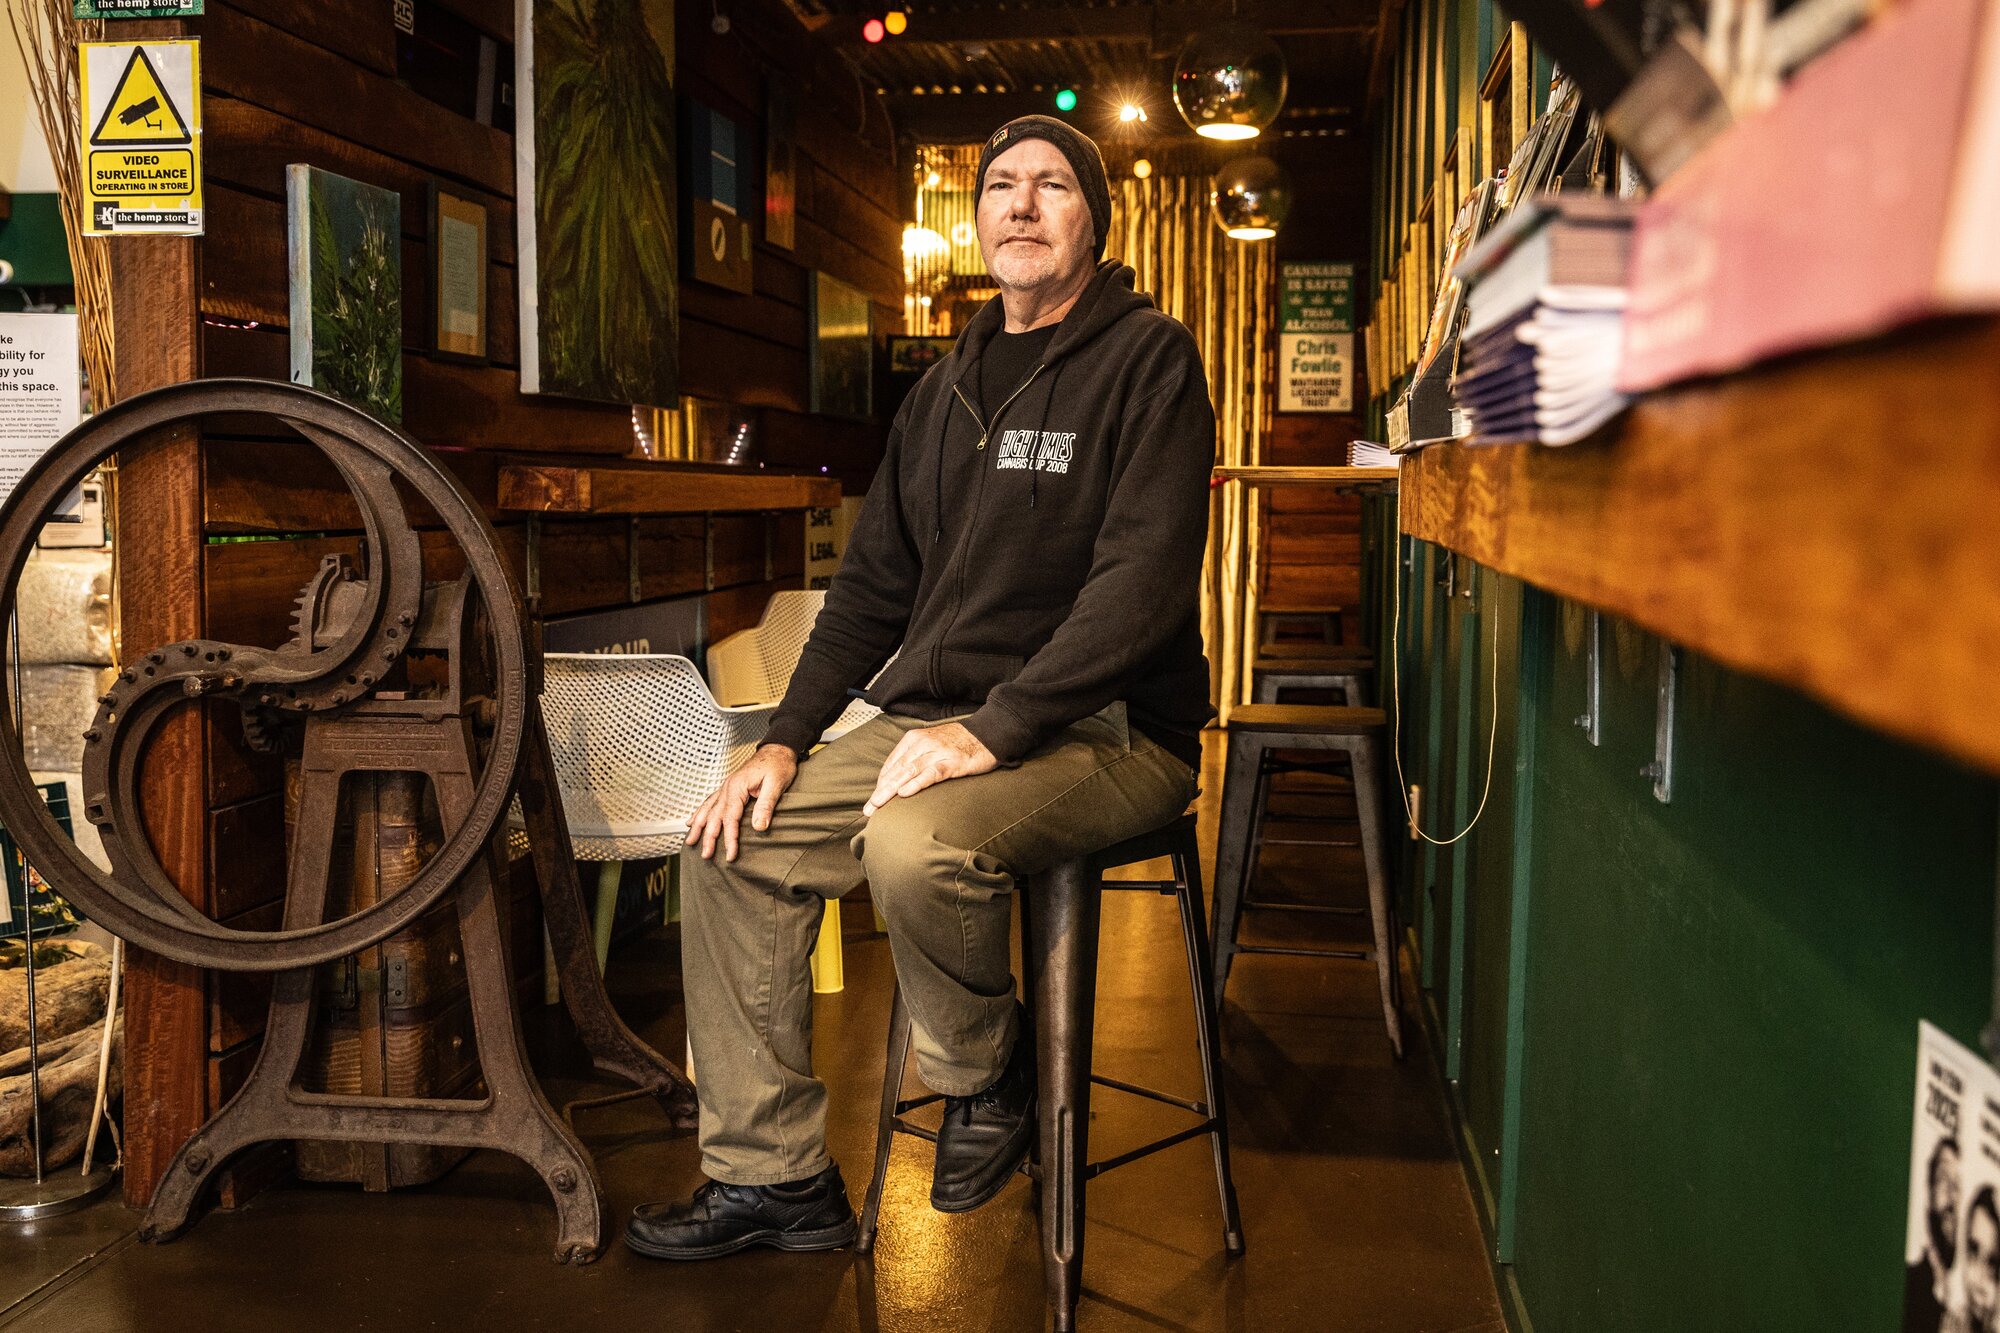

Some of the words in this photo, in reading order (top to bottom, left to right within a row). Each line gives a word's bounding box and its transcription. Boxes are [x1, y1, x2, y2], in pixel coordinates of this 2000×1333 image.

[98, 0, 115, 8] the
[117, 0, 150, 9] hemp
[123, 155, 159, 165] VIDEO
[97, 169, 187, 180] SURVEILLANCE
[96, 182, 146, 191] OPERATING
[148, 182, 157, 190] IN
[160, 182, 188, 190] STORE
[118, 213, 132, 222] the
[134, 212, 162, 223] hemp
[164, 213, 187, 222] store
[1283, 264, 1353, 276] CANNABIS
[1287, 279, 1301, 291] IS
[1304, 279, 1348, 291] SAFER
[1302, 307, 1333, 318] THAN
[1285, 320, 1348, 331] ALCOHOL
[1297, 339, 1337, 355] Chris
[29, 350, 45, 360] for
[1291, 358, 1342, 373] Fowlie
[13, 368, 34, 378] you
[22, 383, 59, 393] space.
[1291, 388, 1340, 397] LICENSING
[1301, 398, 1331, 407] TRUST
[998, 429, 1035, 459] HIGH
[1030, 430, 1076, 462] TIMES
[996, 458, 1028, 470] CANNABIS
[1046, 460, 1069, 474] 2008
[810, 507, 833, 527] SAFE
